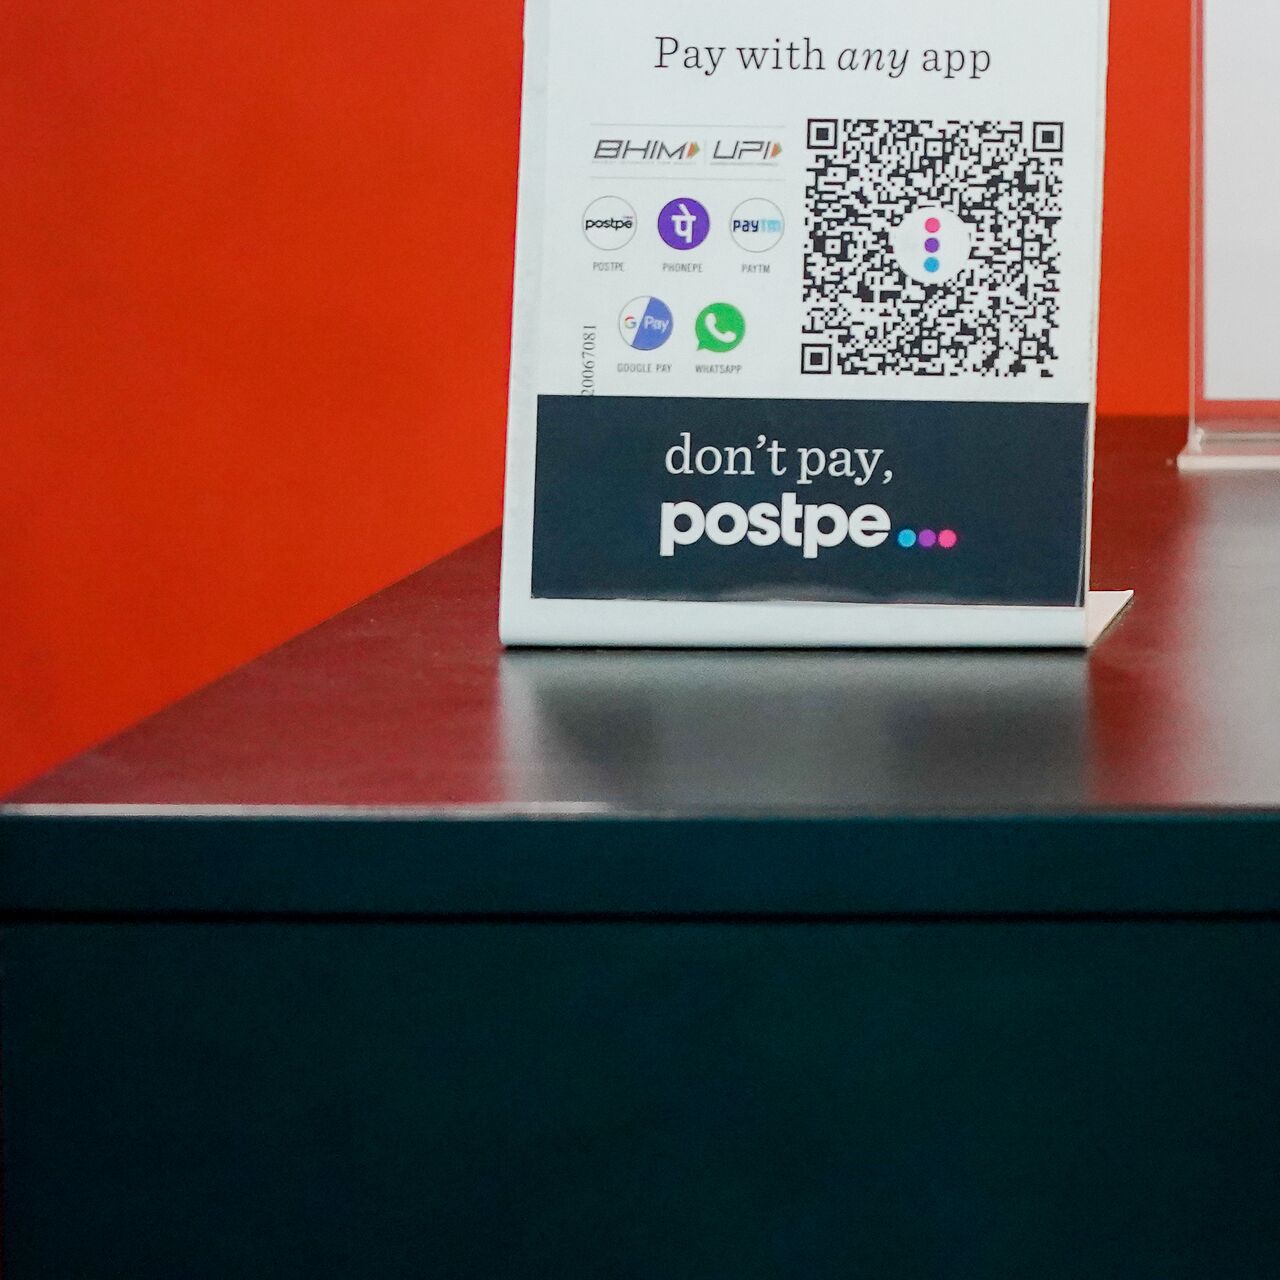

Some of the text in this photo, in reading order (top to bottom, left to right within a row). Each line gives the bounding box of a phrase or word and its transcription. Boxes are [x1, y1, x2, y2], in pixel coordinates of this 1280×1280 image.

[654, 37, 992, 79] Pay with any app
[594, 139, 688, 160] BHIM
[713, 140, 772, 160] UPI
[585, 217, 633, 231] postpe
[593, 261, 625, 272] POSTPE
[662, 262, 703, 273] PHONEPE
[741, 263, 771, 273] PAYTM
[617, 363, 672, 373] GOOGLE PAY
[695, 364, 742, 374] WHATSAPP
[796, 445, 895, 487] pay,
[660, 492, 892, 559] postpe
